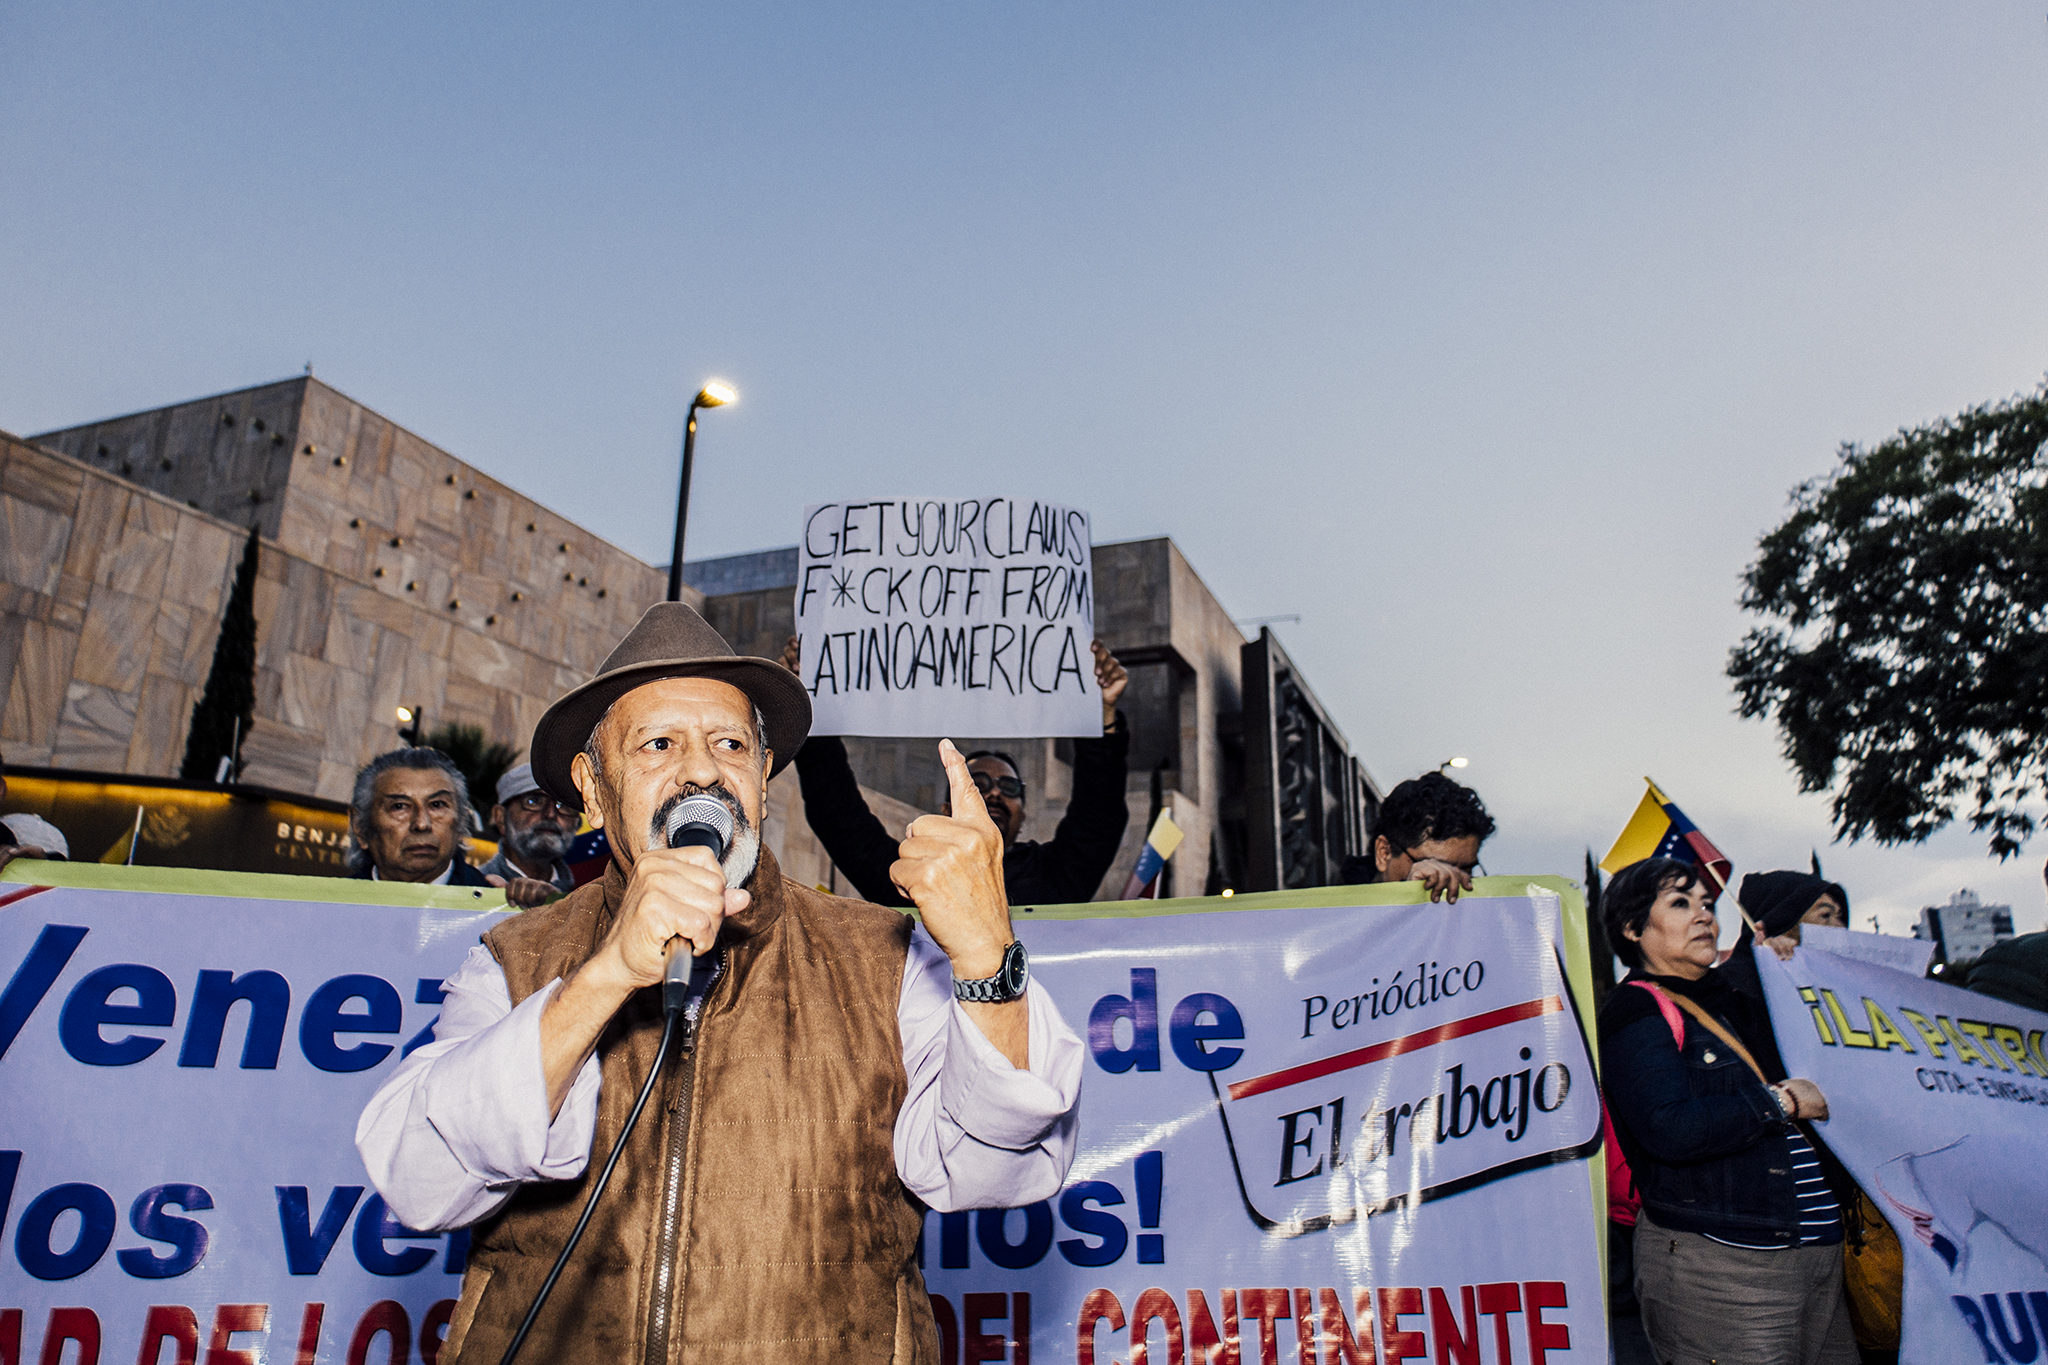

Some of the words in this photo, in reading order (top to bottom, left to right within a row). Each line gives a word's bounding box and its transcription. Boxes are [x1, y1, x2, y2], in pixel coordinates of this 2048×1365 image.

[806, 502, 895, 559] GET
[896, 499, 980, 558] YOUR
[983, 498, 1085, 566] CLAWS
[919, 565, 990, 619] OFF
[1002, 565, 1092, 623] FROM
[798, 621, 1087, 698] LATINOAMERICA
[274, 842, 342, 865] CENTR
[276, 822, 352, 849] BENJA
[1088, 967, 1246, 1074] de
[1300, 959, 1485, 1040] Periódico
[1796, 985, 1916, 1054] ¡LA
[1273, 1095, 1349, 1188] El
[275, 1184, 471, 1277] ve
[136, 1303, 271, 1365] DE
[1077, 1281, 1571, 1365] CONTINENTE
